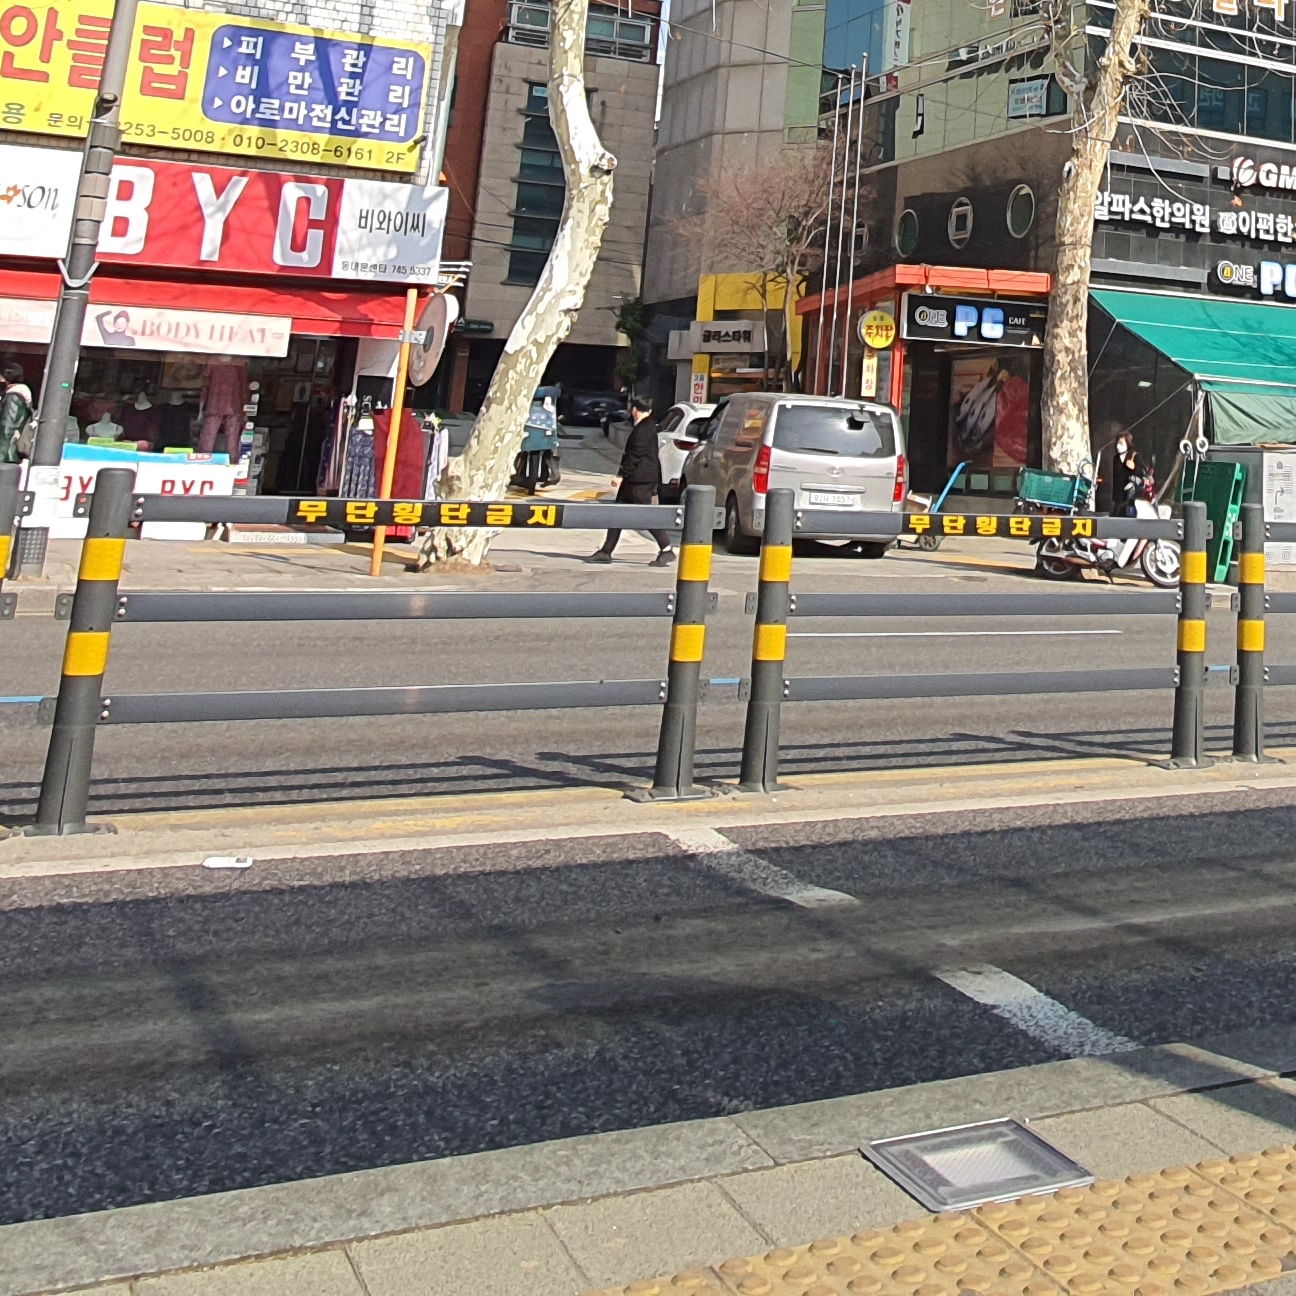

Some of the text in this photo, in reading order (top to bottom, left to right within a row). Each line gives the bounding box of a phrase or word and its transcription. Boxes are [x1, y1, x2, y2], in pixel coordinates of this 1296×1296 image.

[238, 35, 415, 81] 피부관리
[234, 64, 411, 109] 비만관리
[230, 93, 408, 138] 아로마전신관리
[46, 112, 84, 131] 문의
[116, 120, 216, 145] 253-5008
[232, 133, 374, 163] 010-2308-6161
[385, 150, 408, 165] 2F
[97, 164, 329, 269] BYC
[358, 207, 427, 238] 비와이씨
[140, 318, 203, 341] BODY
[953, 304, 1005, 339] PC
[296, 500, 558, 526] 무단횡단금지
[908, 514, 1095, 537] 무단횡단금지
